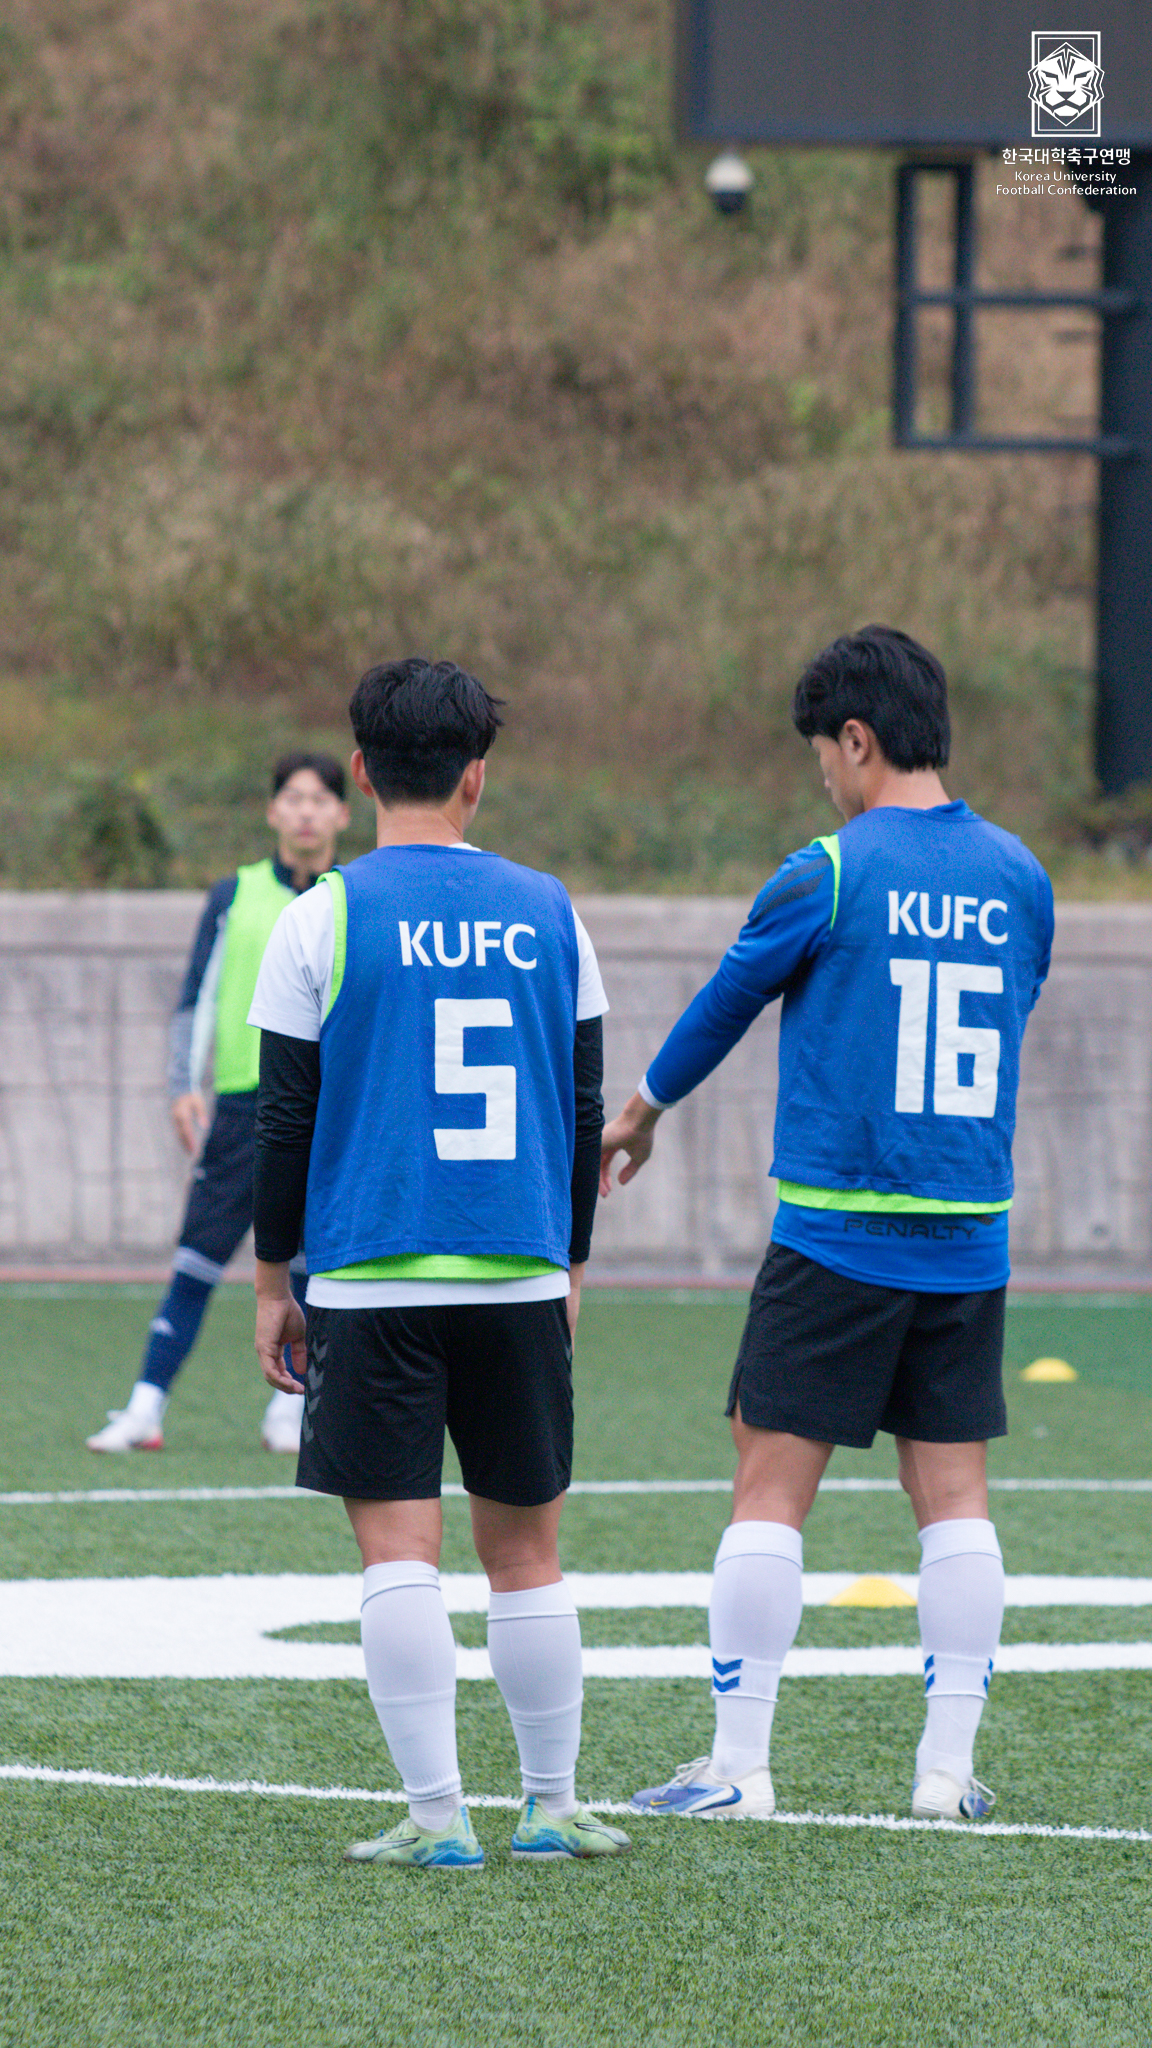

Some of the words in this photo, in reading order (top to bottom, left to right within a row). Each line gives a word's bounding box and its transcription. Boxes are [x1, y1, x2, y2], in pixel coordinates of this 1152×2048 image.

[398, 920, 538, 970] KUFC
[889, 890, 1009, 945] KUFC
[889, 958, 1004, 1118] 16
[433, 998, 517, 1161] 5
[843, 1217, 978, 1241] PENALTY
